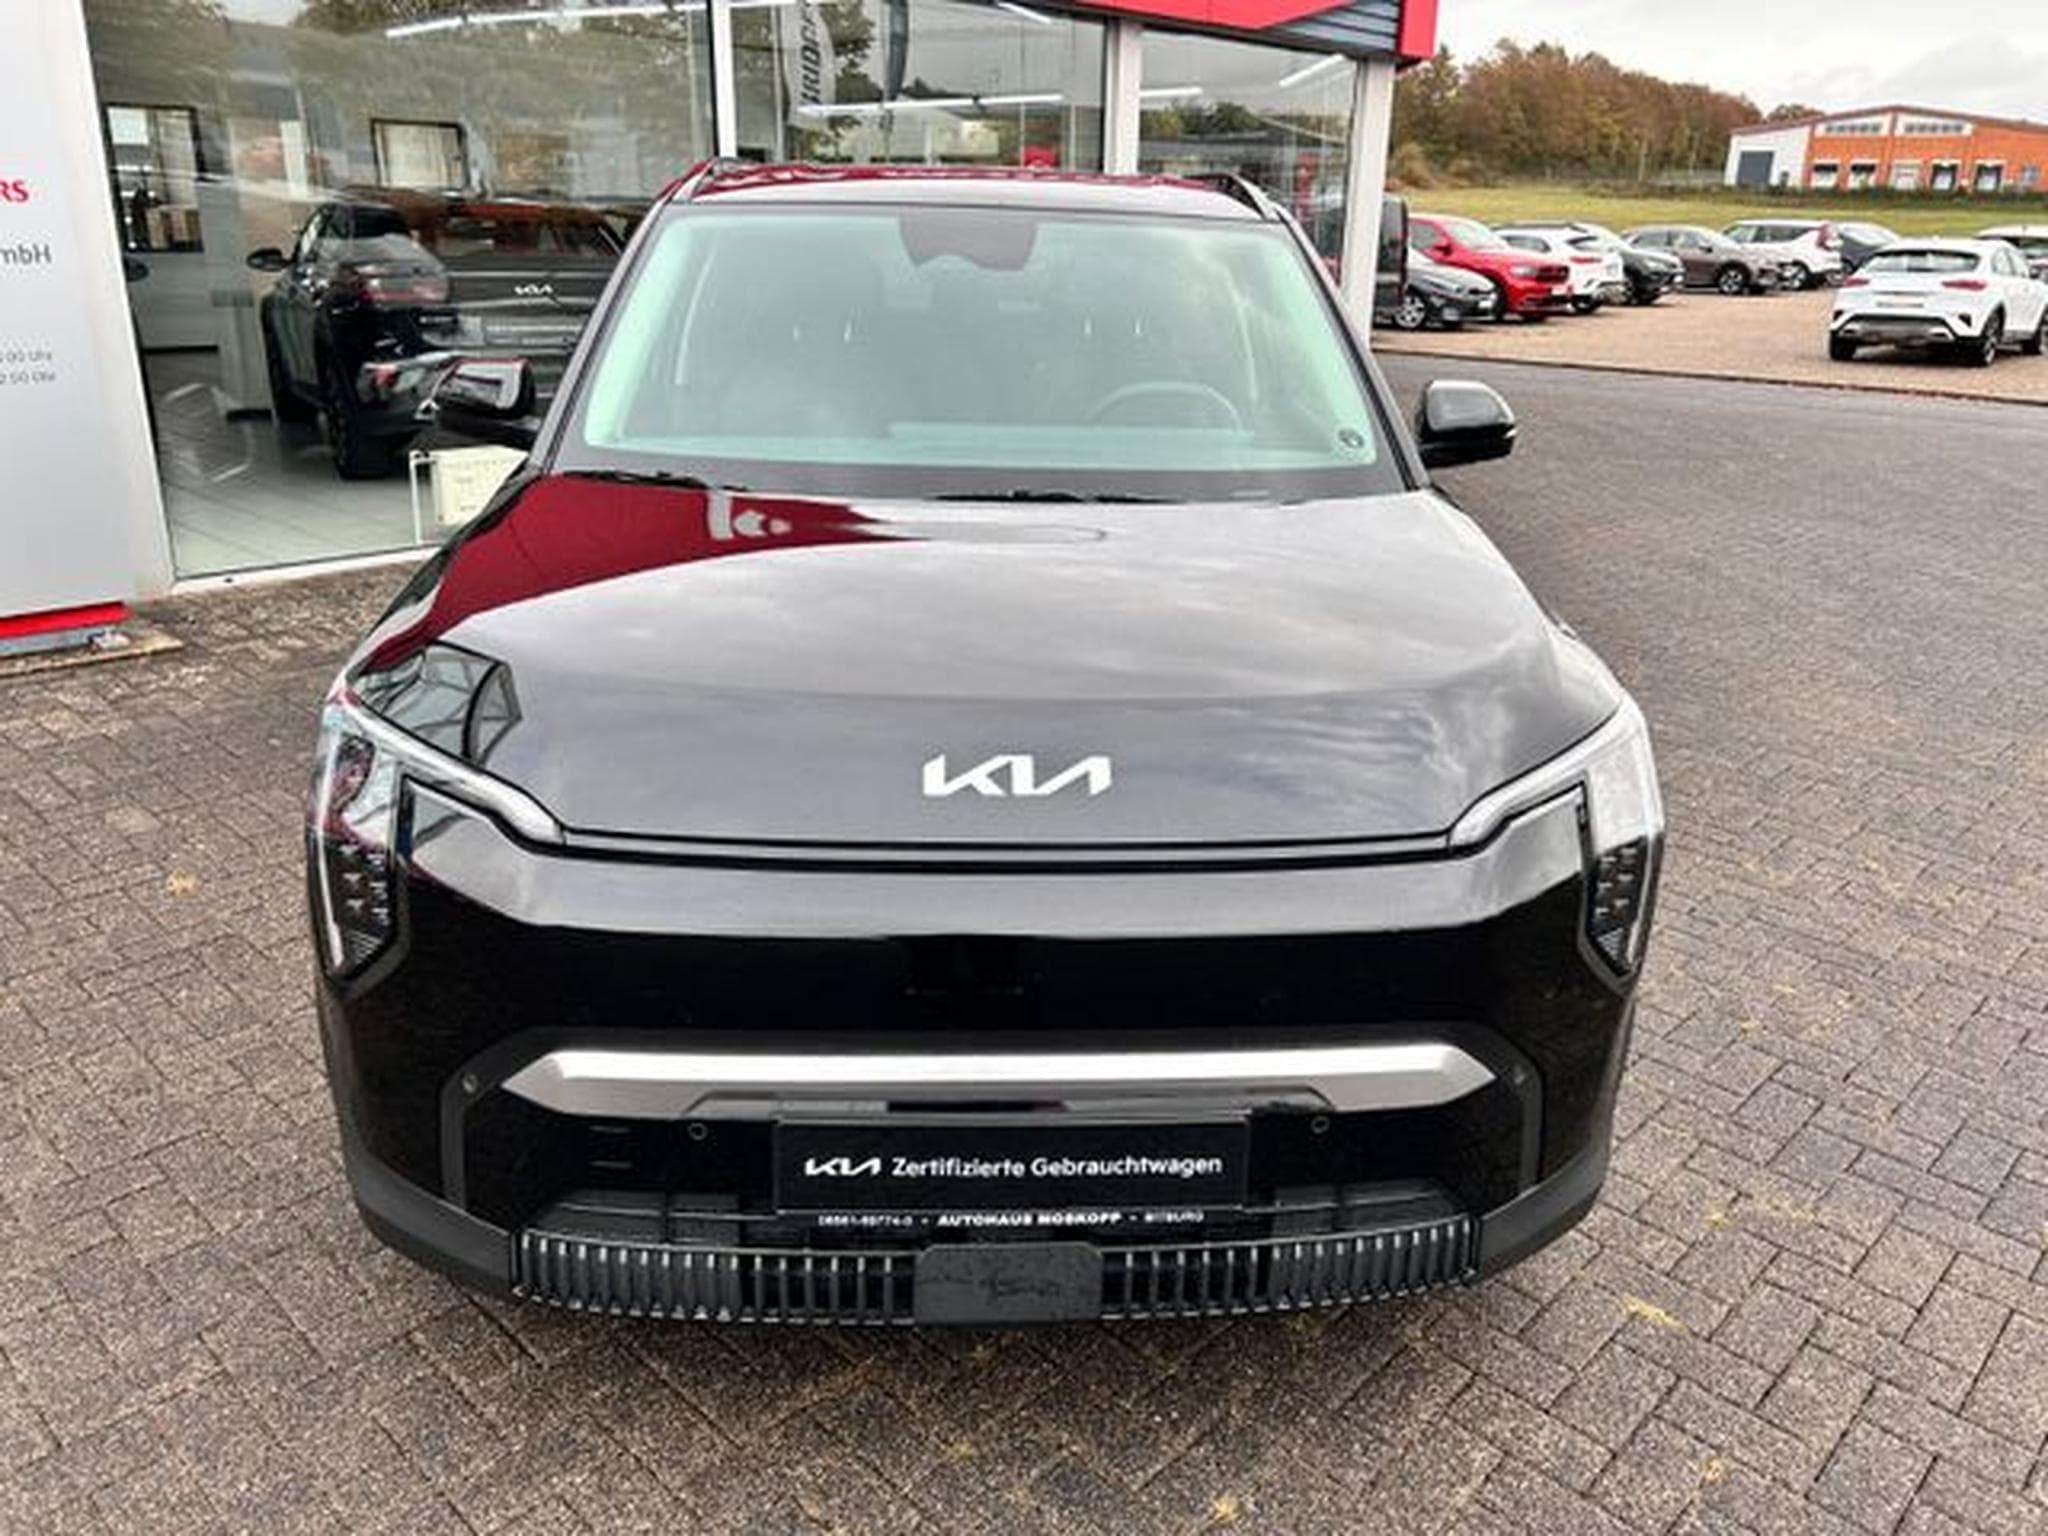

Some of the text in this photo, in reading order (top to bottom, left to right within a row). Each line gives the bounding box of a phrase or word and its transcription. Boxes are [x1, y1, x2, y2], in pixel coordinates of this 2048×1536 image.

[923, 754, 1112, 797] KIA
[804, 1155, 1223, 1179] KIA Zertifizierte Gebrauchtwagen
[937, 1213, 1033, 1228] AUTOHAUS
